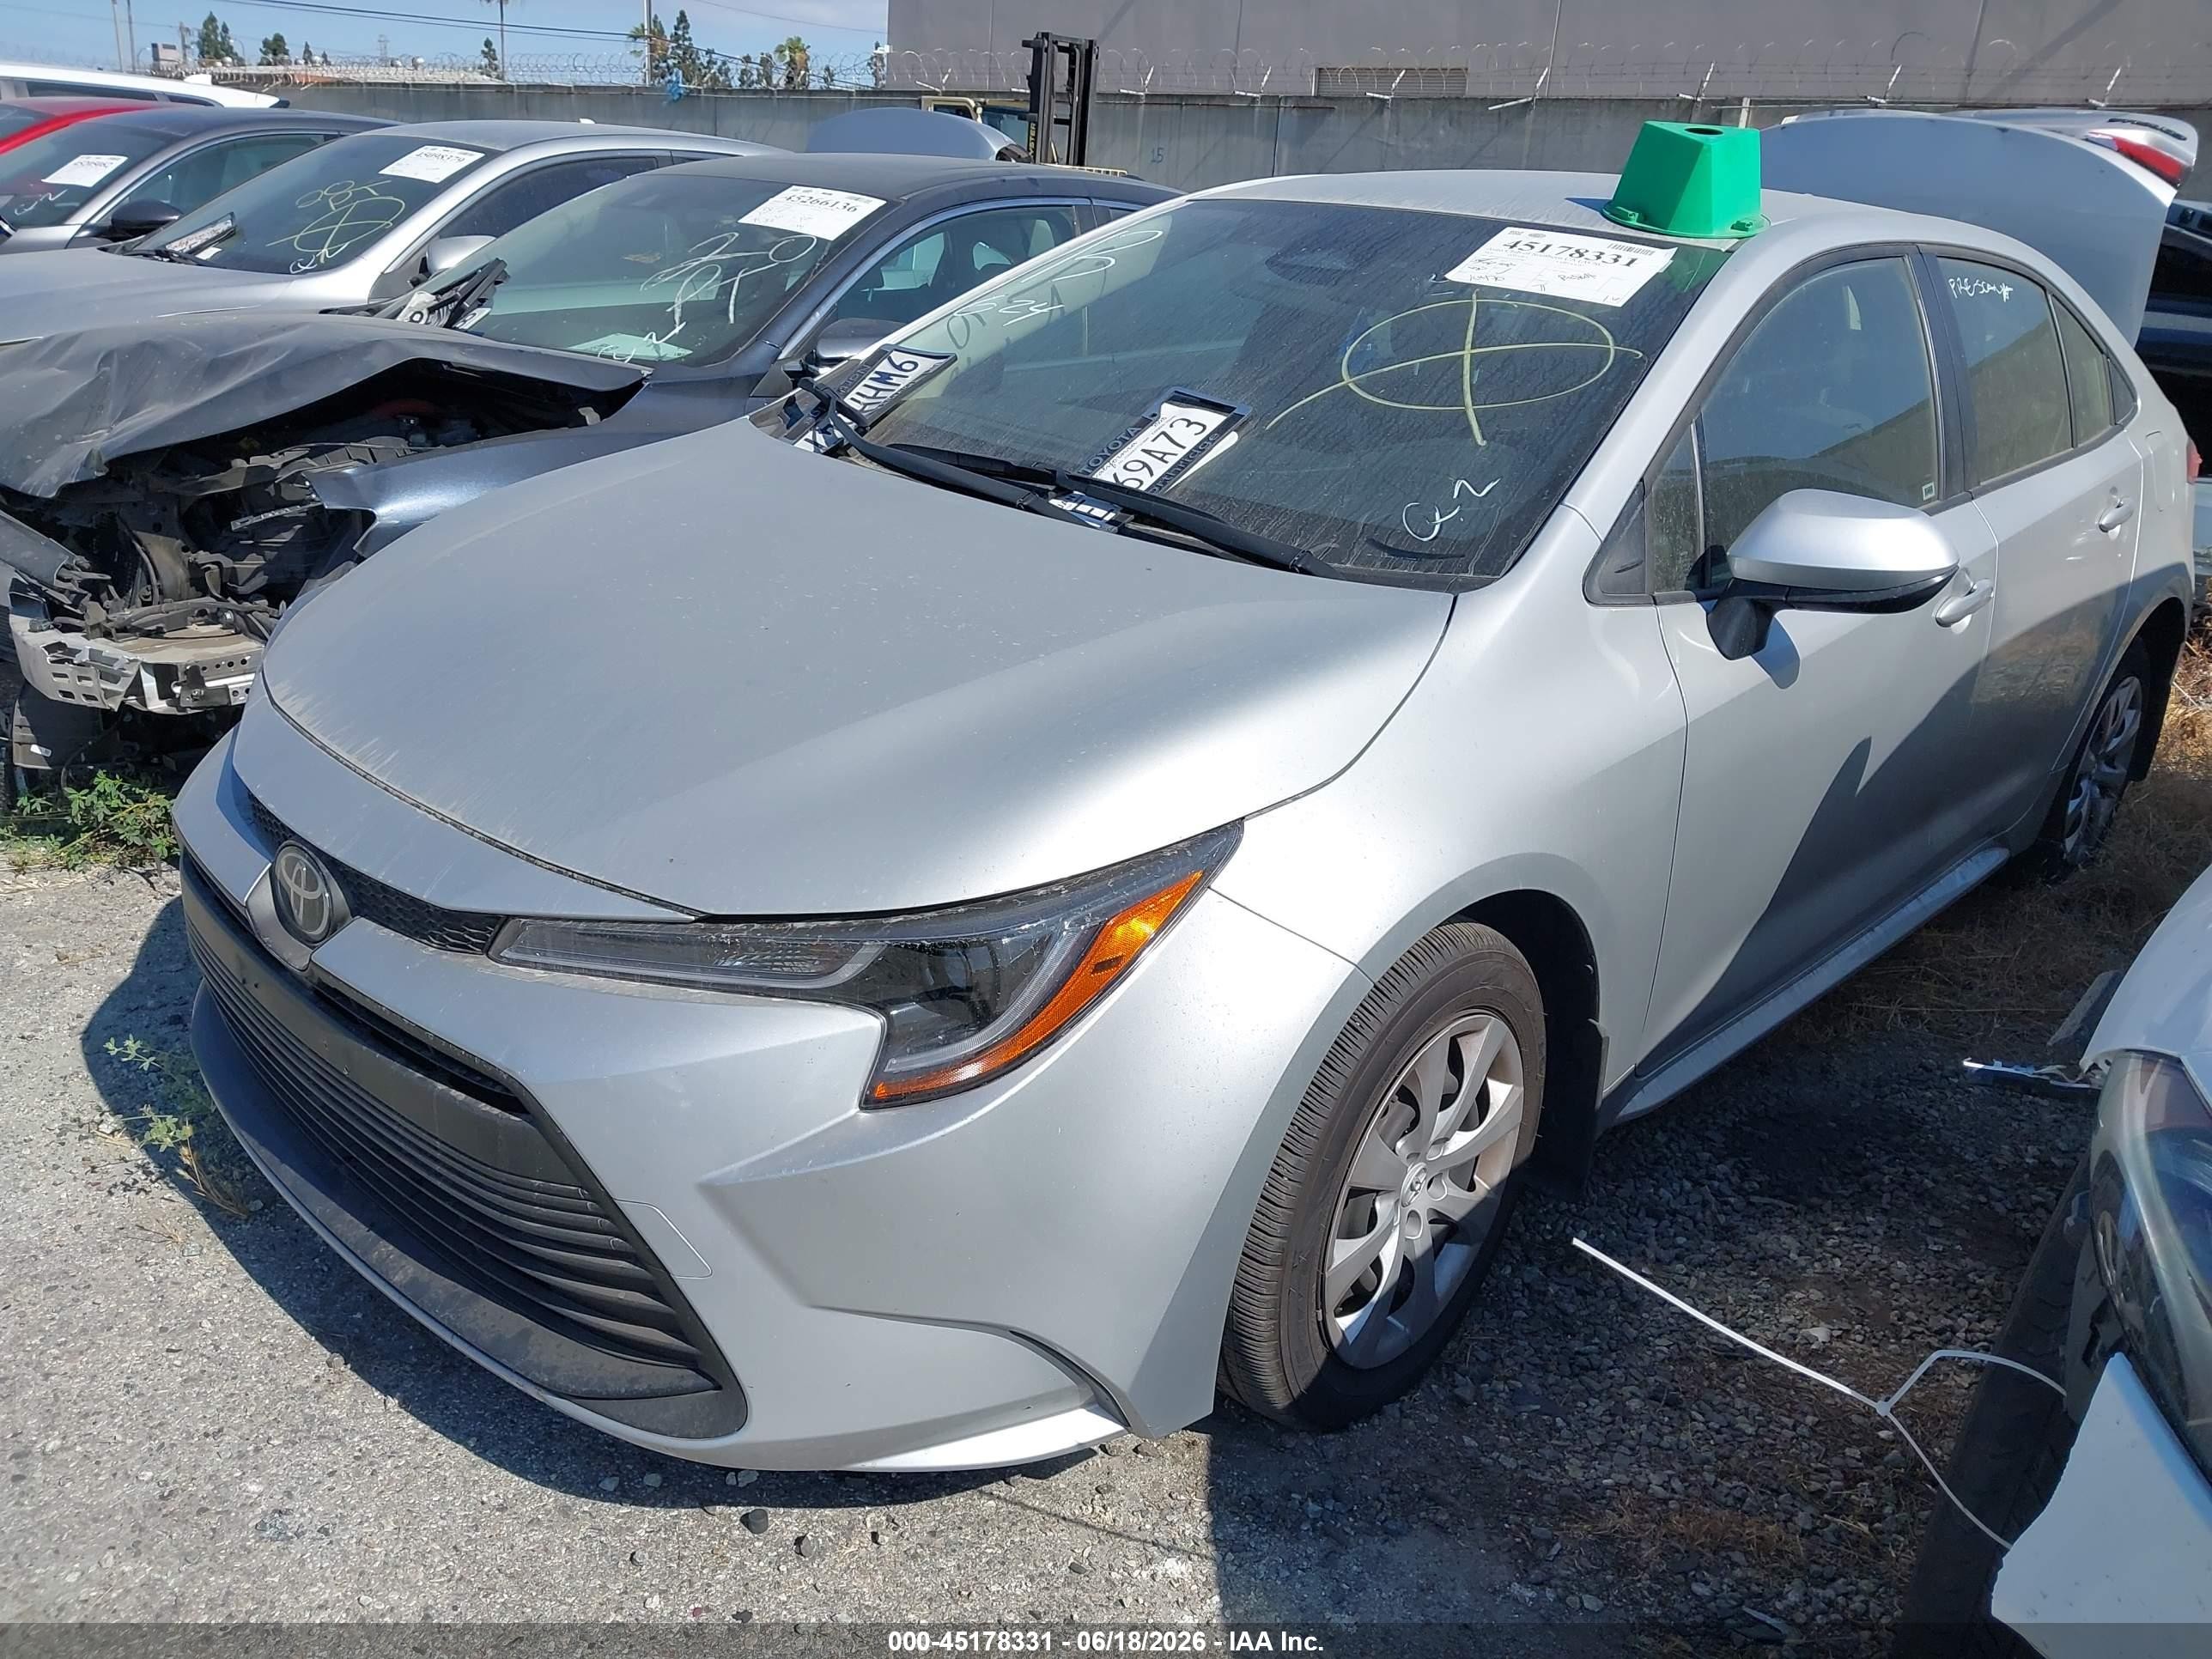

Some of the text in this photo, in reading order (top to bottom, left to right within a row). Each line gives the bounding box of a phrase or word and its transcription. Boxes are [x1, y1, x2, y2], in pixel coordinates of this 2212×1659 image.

[1029, 123, 1037, 156] YSTER
[785, 194, 858, 214] 45266136
[1502, 239, 1639, 267] 45178331
[1079, 424, 1143, 475] TOYOTA
[1149, 431, 1220, 495] orthridge
